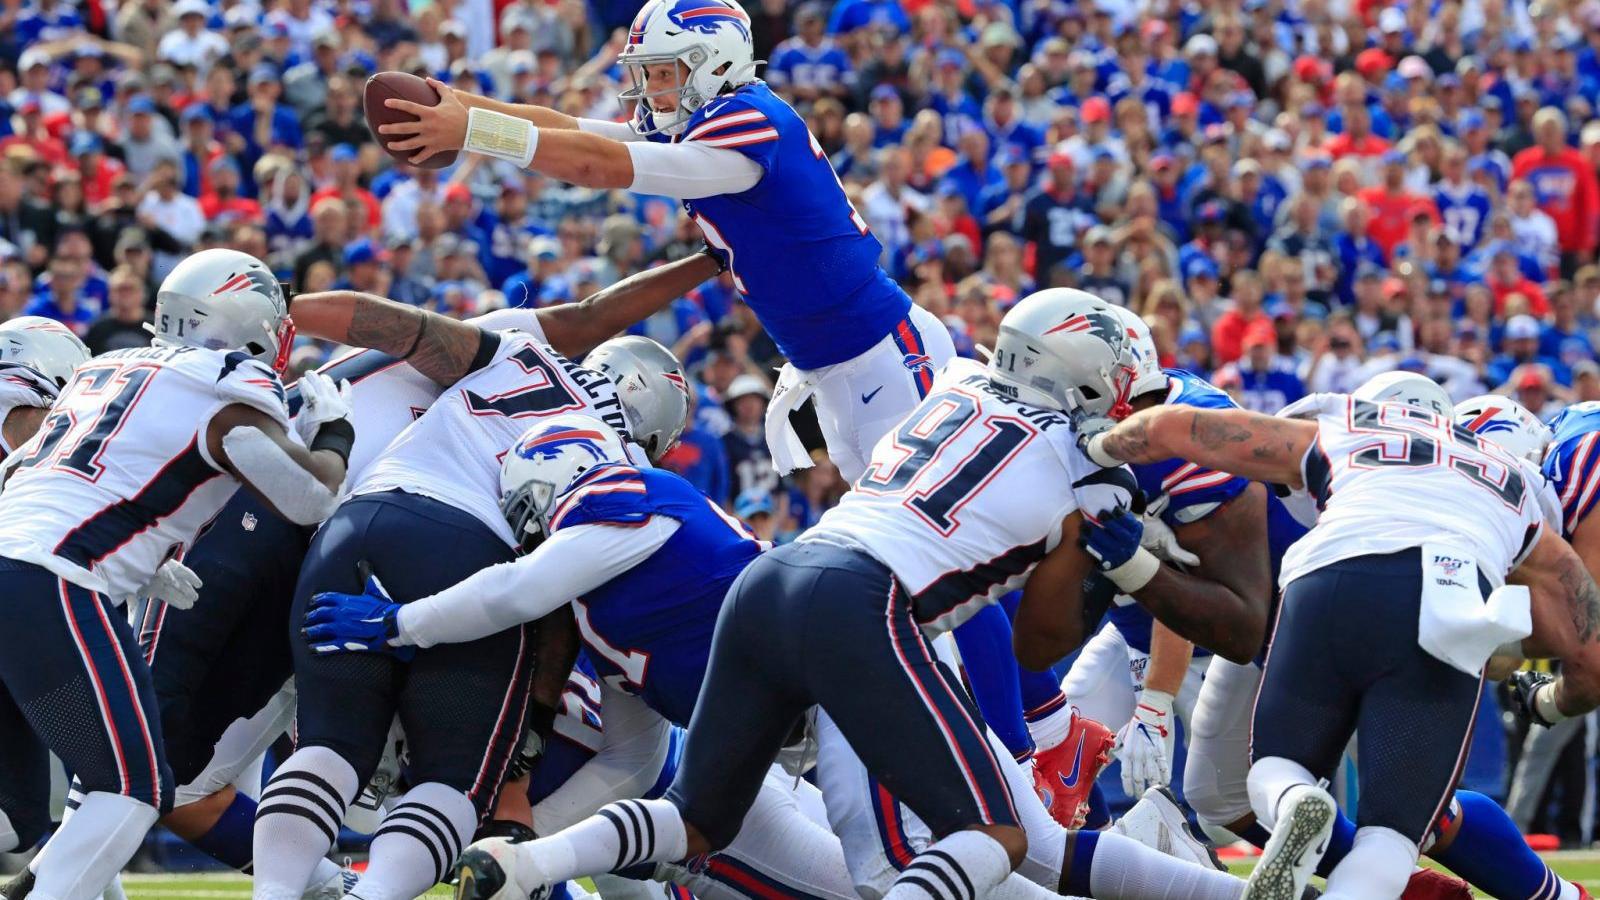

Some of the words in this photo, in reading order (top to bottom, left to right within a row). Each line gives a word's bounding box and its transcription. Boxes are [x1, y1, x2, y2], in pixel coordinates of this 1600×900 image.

[160, 314, 185, 338] 51
[996, 348, 1016, 373] 91
[1017, 406, 1068, 432] JR
[855, 387, 1038, 538] 91
[1348, 393, 1527, 516] 55
